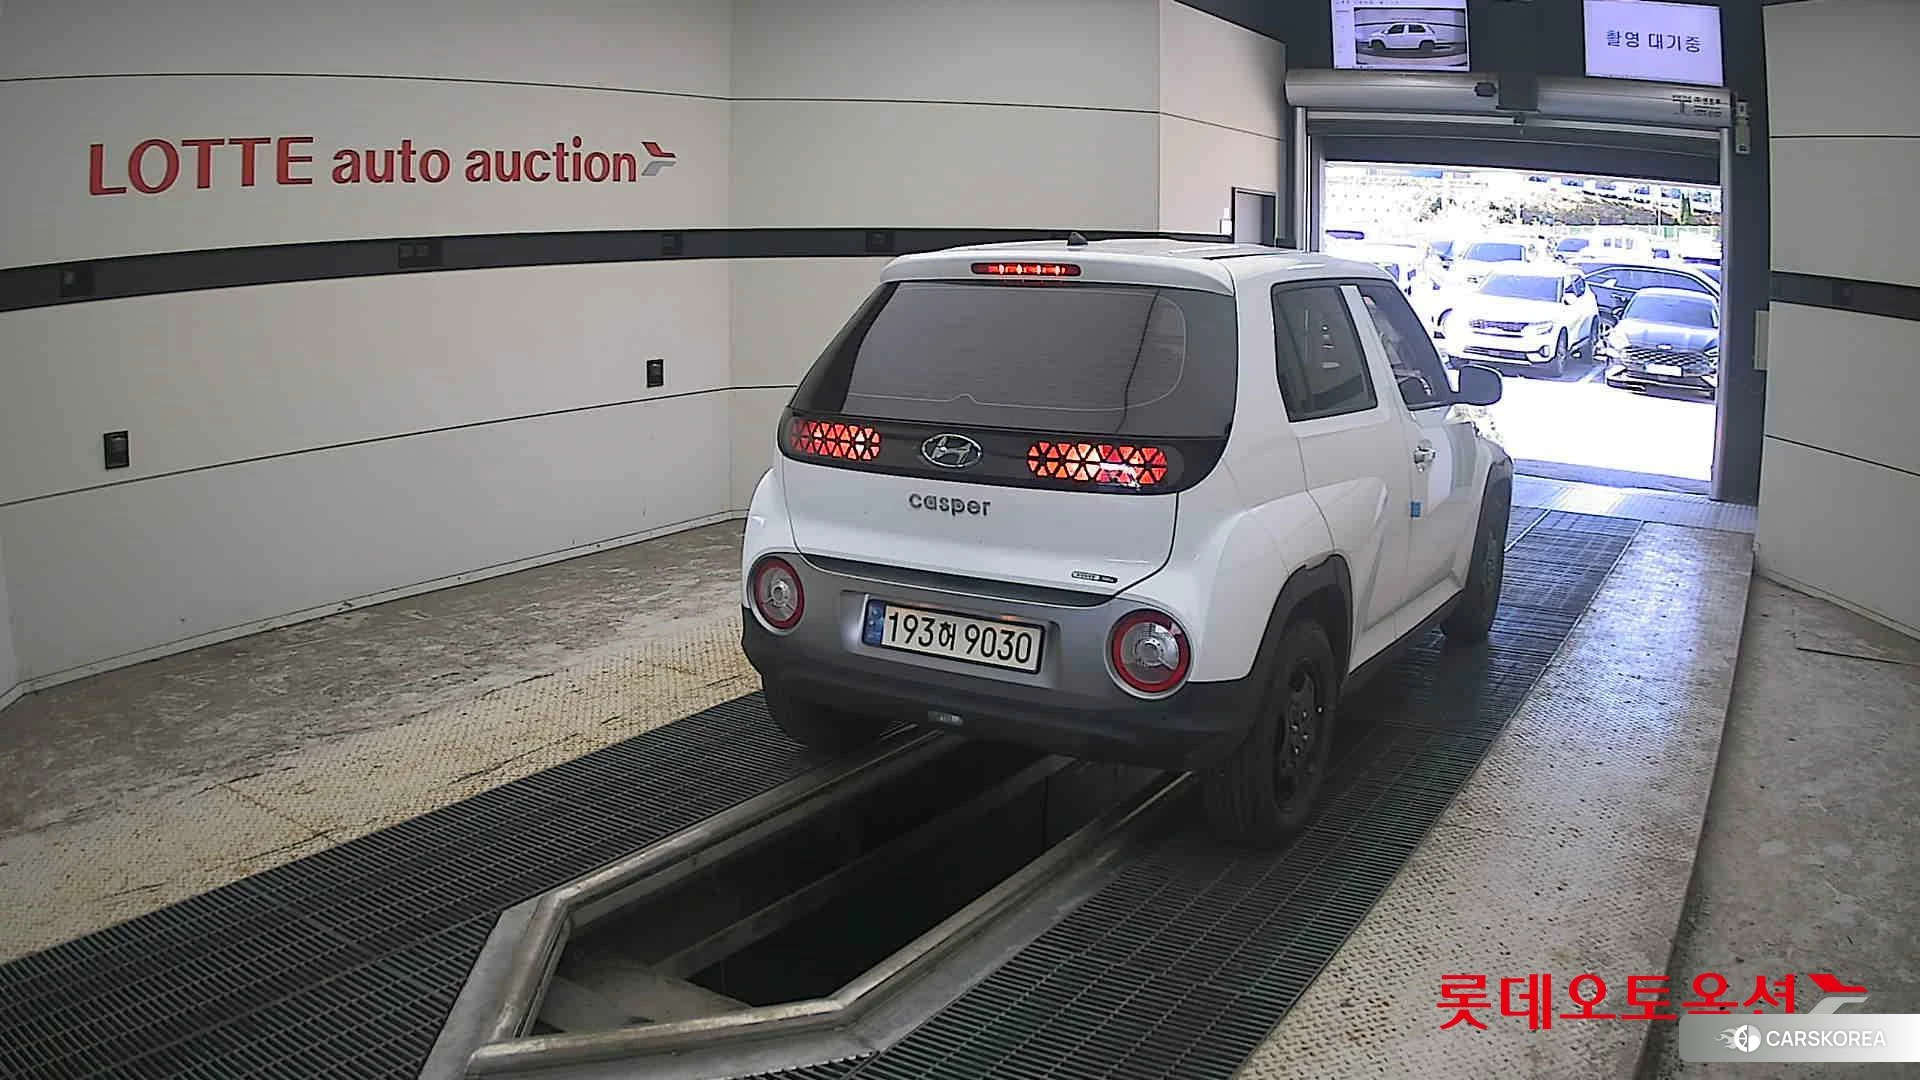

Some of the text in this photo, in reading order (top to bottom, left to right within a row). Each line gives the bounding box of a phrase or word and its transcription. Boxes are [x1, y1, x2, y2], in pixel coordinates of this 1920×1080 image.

[1606, 29, 1702, 53] 촬영 대기중
[90, 136, 638, 195] LOTTE auto auction
[908, 493, 991, 517] casper
[888, 611, 1033, 664] 193허 9030
